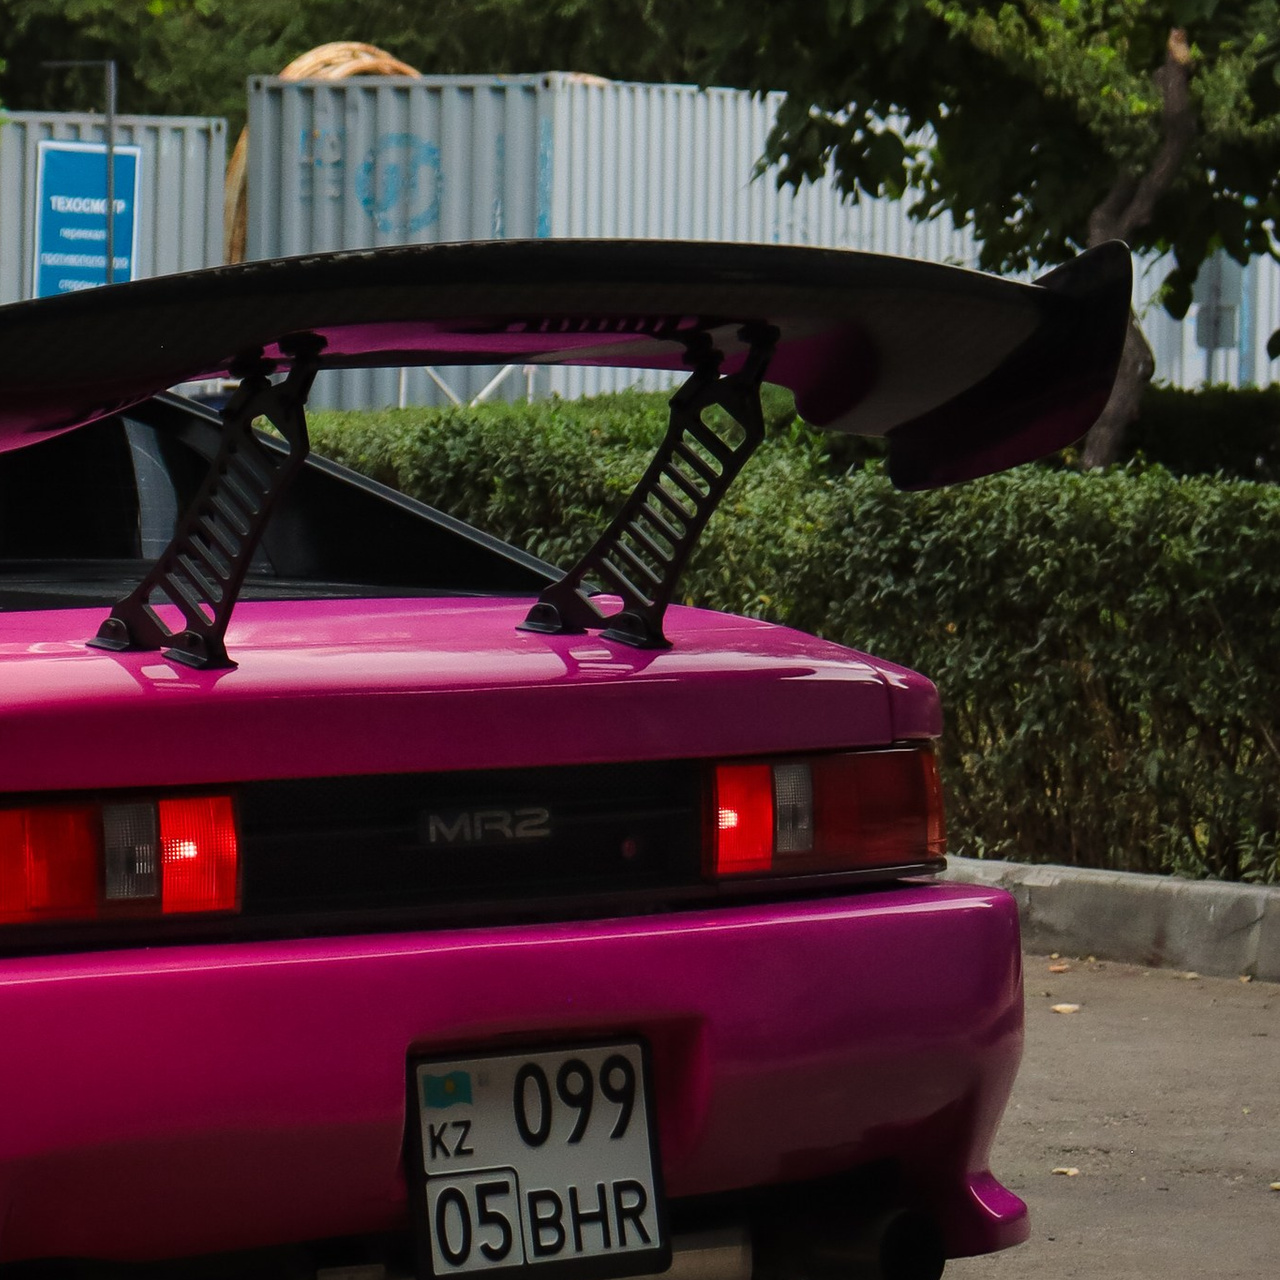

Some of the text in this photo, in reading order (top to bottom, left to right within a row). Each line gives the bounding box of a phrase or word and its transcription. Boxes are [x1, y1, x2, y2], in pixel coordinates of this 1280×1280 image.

[428, 807, 550, 843] MR2
[513, 1054, 636, 1147] 099
[428, 1120, 474, 1159] KZ
[435, 1179, 651, 1266] 05 BHR
